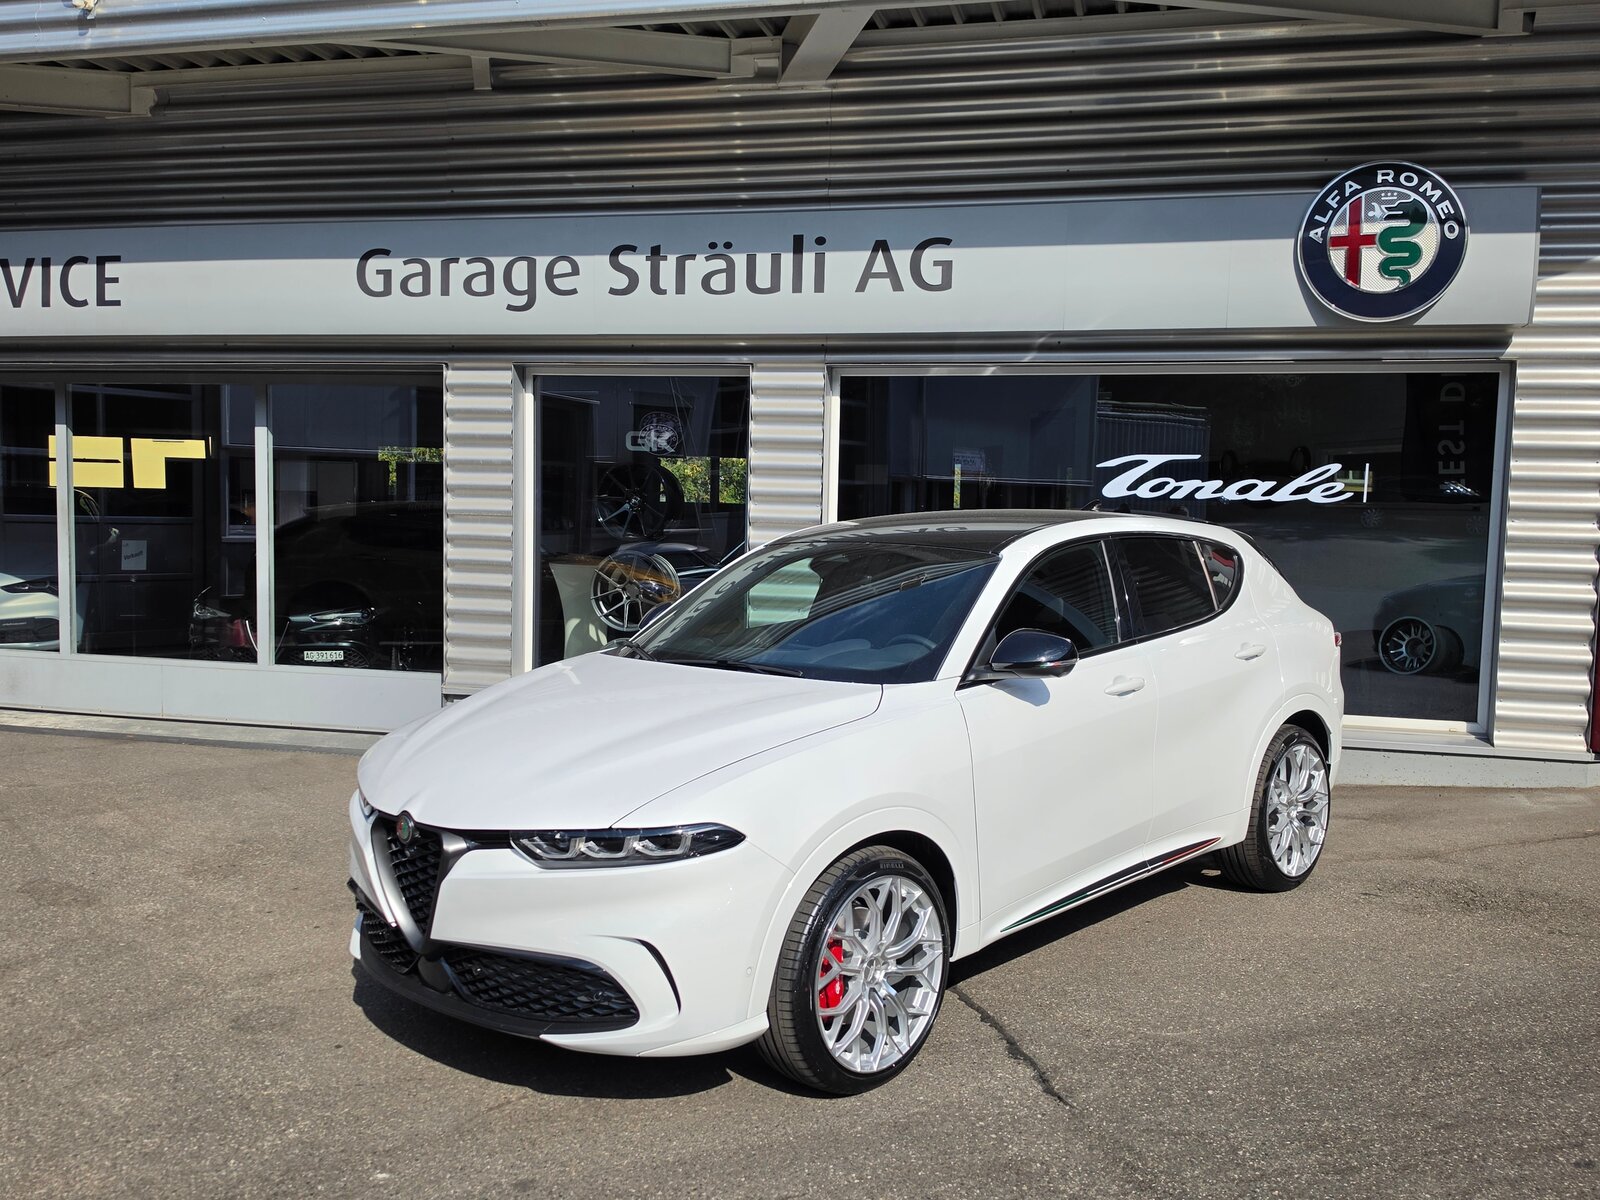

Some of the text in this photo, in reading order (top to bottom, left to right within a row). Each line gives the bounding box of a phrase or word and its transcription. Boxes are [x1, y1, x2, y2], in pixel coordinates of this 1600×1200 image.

[1309, 169, 1460, 244] ALFA ROMEO
[0, 255, 121, 309] VICE
[356, 234, 954, 312] Garage Sträuli AG
[1095, 454, 1355, 504] Tonale
